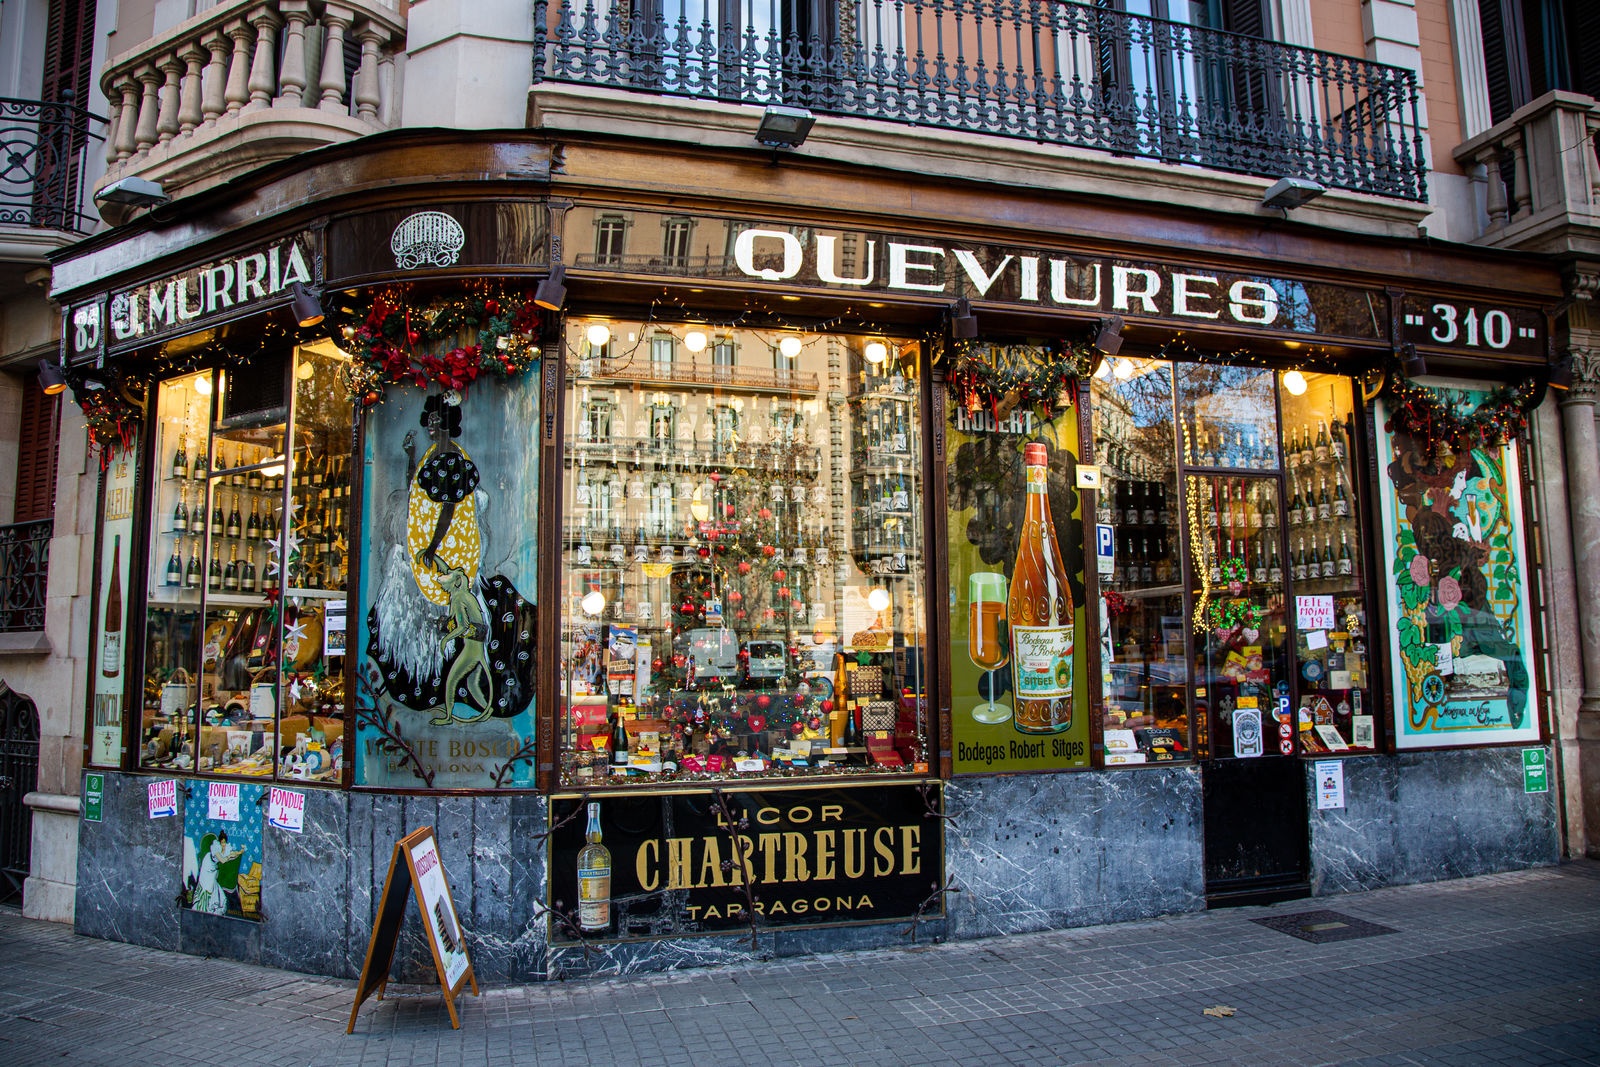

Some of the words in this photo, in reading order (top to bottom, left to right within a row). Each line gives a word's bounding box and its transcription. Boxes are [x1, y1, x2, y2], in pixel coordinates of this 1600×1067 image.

[149, 240, 312, 331] MURRIA
[734, 228, 1280, 325] QUEVIURES
[1099, 527, 1111, 555] P
[1019, 633, 1053, 645] Bodegas
[1023, 676, 1054, 686] SITGES
[1280, 697, 1289, 713] P
[449, 738, 519, 757] BOSCH
[958, 741, 1006, 765] Bodegas
[1009, 739, 1045, 760] Robert
[1052, 739, 1084, 761] Sitges
[149, 780, 175, 797] OFERTA
[210, 783, 239, 797] FONDUE
[150, 794, 176, 810] FONDUE
[271, 789, 304, 811] FONDUE
[717, 804, 844, 827] LICOR
[635, 825, 922, 892] CHARTREUSE
[686, 895, 875, 921] TARRAGONA
